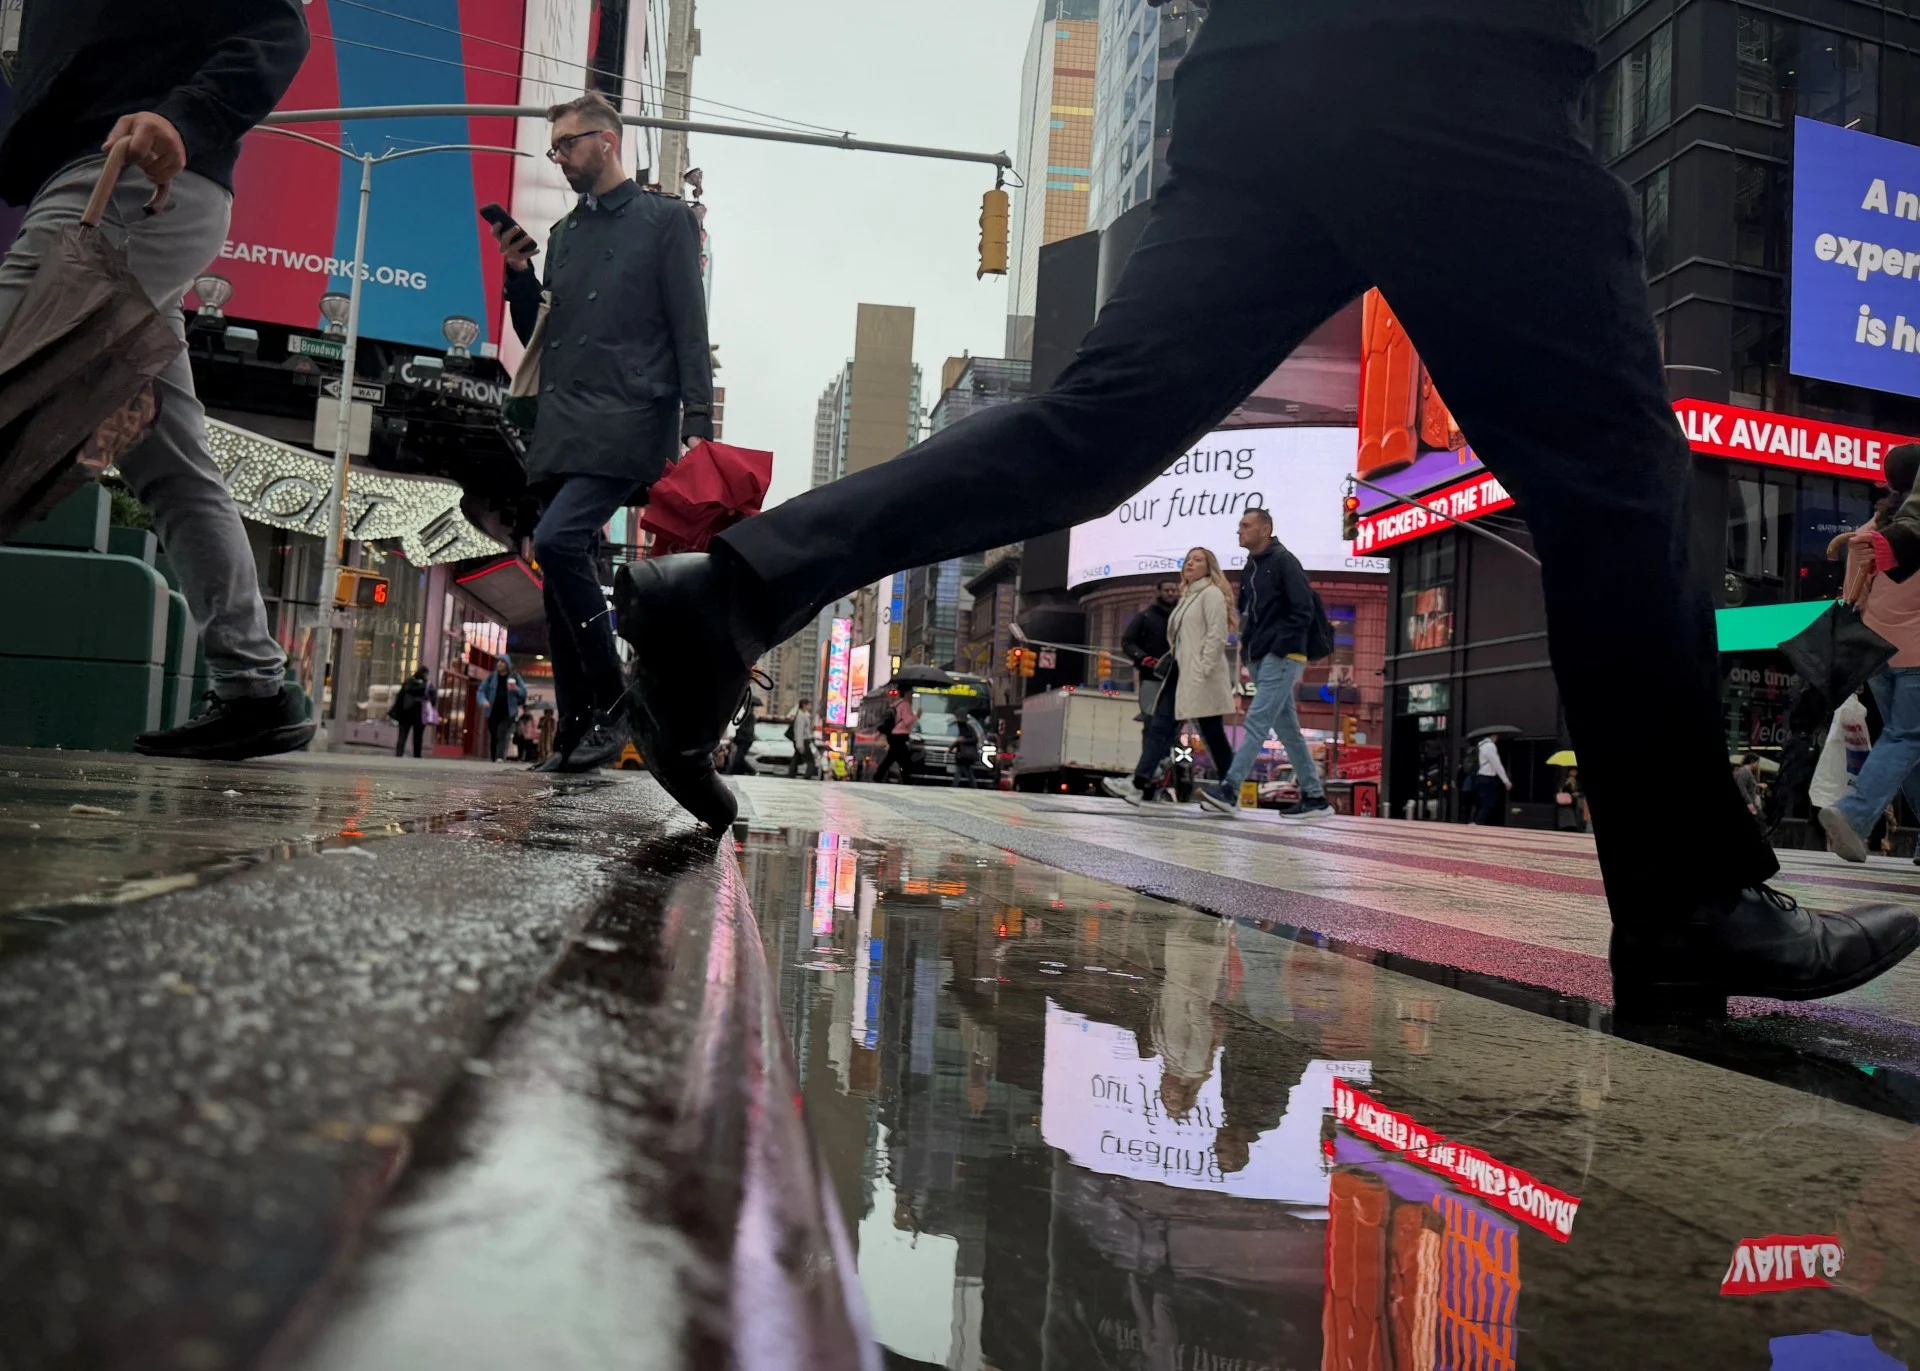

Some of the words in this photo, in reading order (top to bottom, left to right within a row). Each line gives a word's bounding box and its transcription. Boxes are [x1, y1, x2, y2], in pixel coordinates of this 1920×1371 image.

[1861, 178, 1889, 214] A
[1894, 190, 1920, 221] n
[1814, 233, 1920, 282] exper
[1855, 304, 1887, 347] is
[301, 341, 341, 359] Broadway
[358, 386, 377, 399] WAY
[1728, 418, 1882, 471] AVAILABLE
[1118, 496, 1160, 524] our
[1376, 506, 1428, 541] TICKETS
[1428, 497, 1449, 525] TO
[1450, 485, 1478, 516] THE
[1138, 558, 1175, 571] CHASE
[1729, 667, 1761, 684] one
